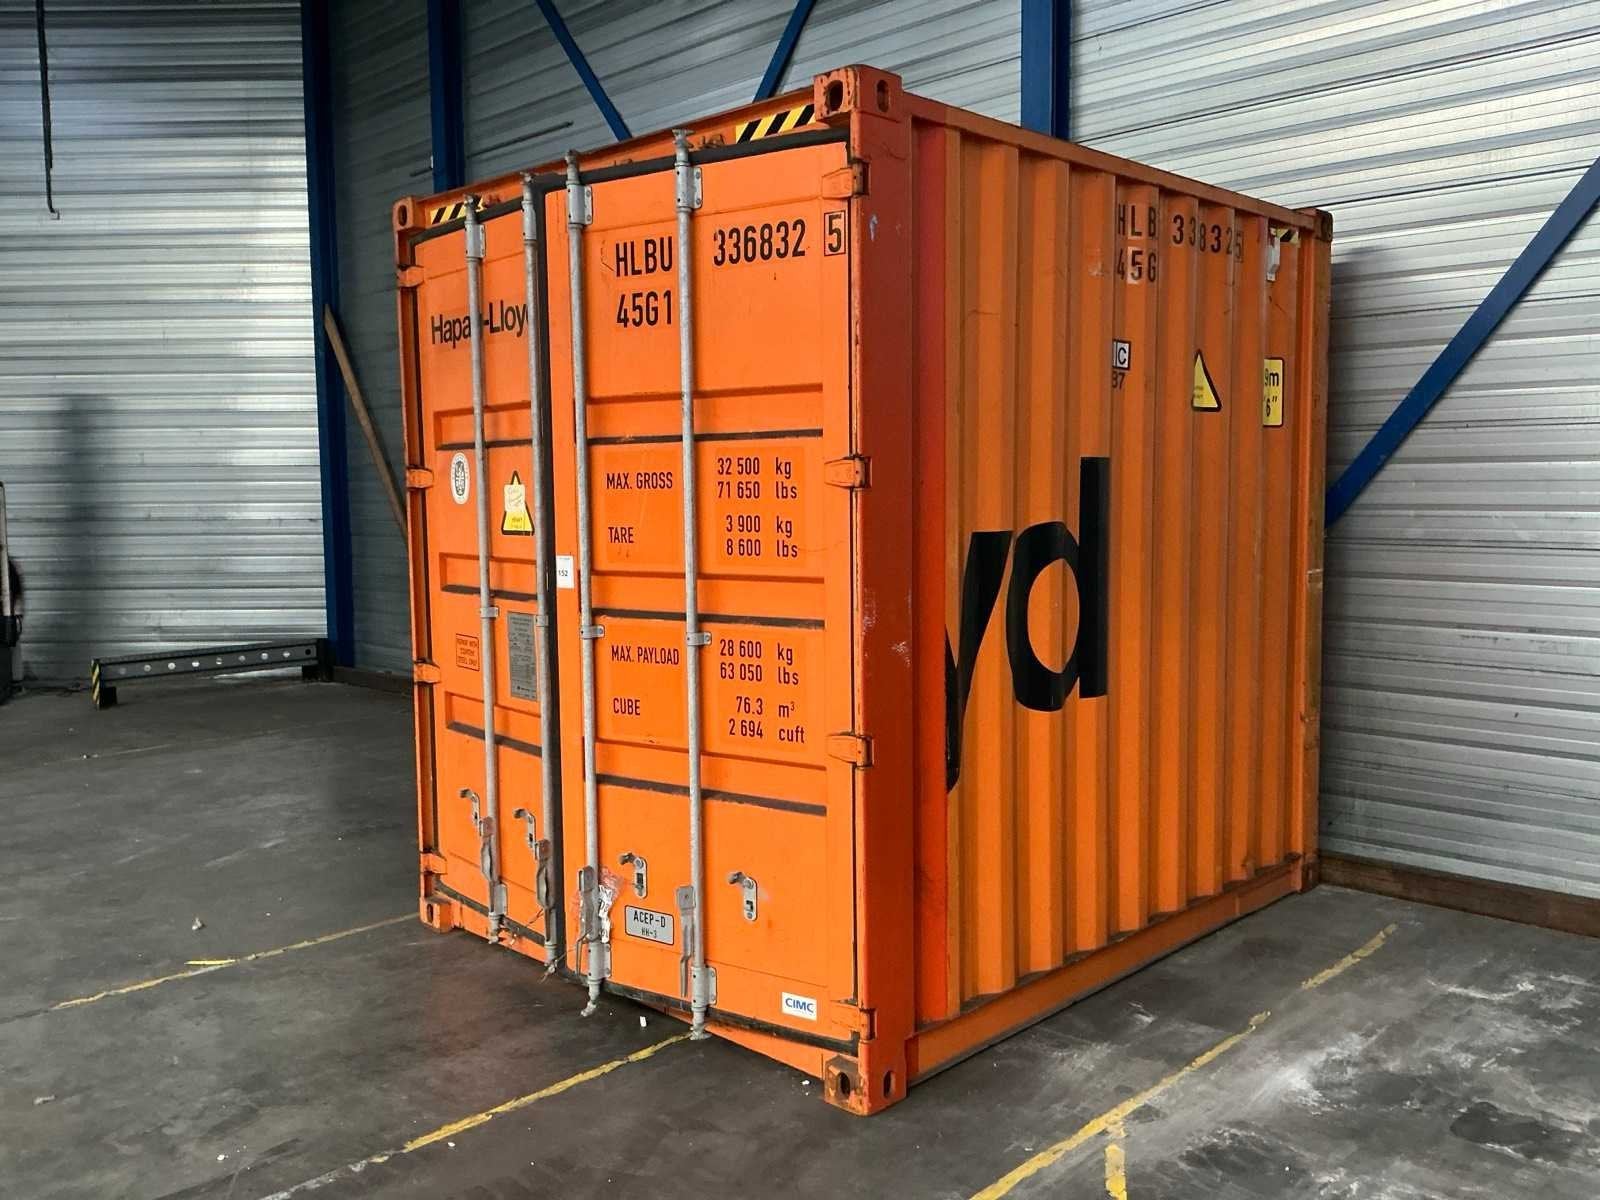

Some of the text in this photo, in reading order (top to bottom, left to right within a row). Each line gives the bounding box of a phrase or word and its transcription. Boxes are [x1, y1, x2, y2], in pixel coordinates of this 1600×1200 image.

[615, 214, 842, 277] HLBU 336832 5
[616, 289, 672, 328] 45G1
[431, 299, 529, 349] Hapa-Lloy
[606, 456, 792, 490] MAX. GROSS 32 500 kg
[717, 481, 798, 499] 71 650 lbs
[608, 515, 793, 544] TARE 3 900 kg
[726, 539, 798, 558] 8 600 lbs
[611, 639, 793, 666] MAX. PAYLOAD 28 600 kg
[720, 662, 799, 685] 63 050 lbs
[613, 697, 641, 716] CUBE
[736, 696, 763, 715] 76.3
[728, 719, 805, 743] 2 694 cuft
[633, 910, 666, 928] ACEP-D
[785, 997, 814, 1014] CIMC
